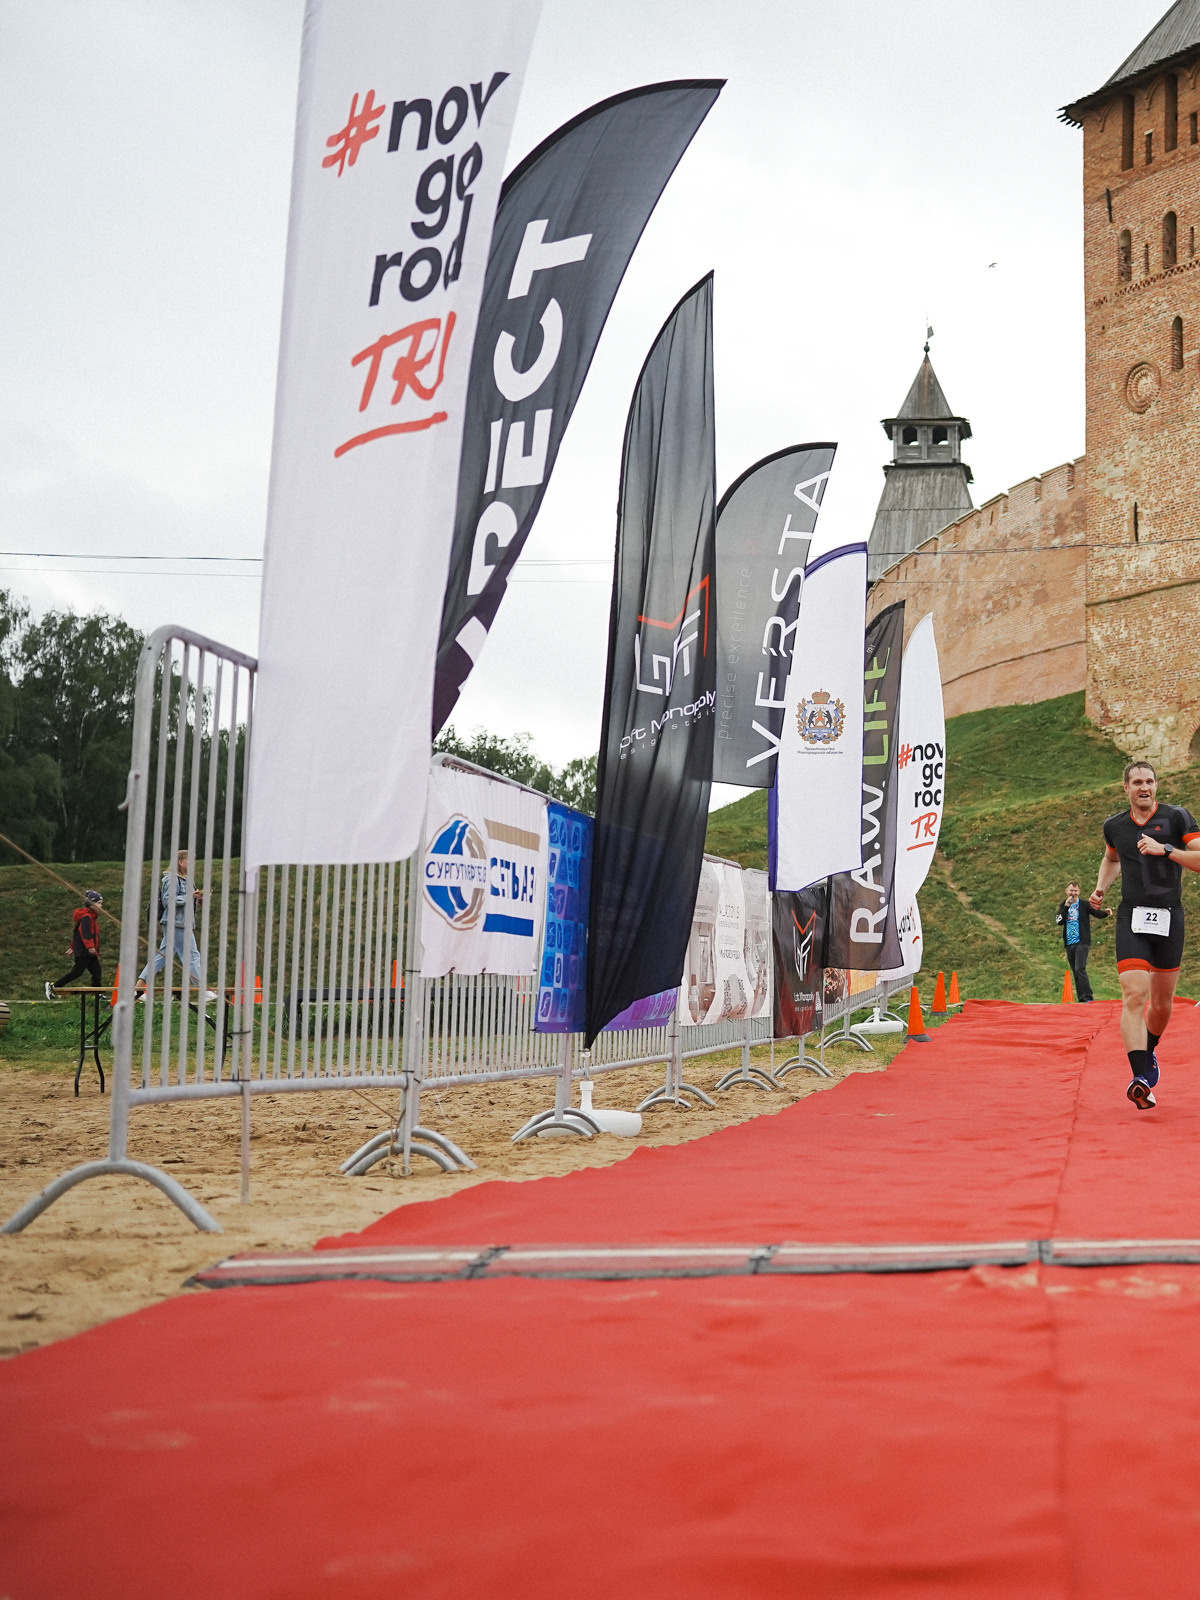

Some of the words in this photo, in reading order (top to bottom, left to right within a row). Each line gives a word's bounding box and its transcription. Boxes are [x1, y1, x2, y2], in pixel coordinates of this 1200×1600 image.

[322, 72, 511, 178] #nov
[411, 142, 483, 240] go
[369, 193, 474, 307] rod
[351, 311, 457, 413] TRI
[728, 567, 753, 665] excellence
[746, 470, 831, 768] VERSTA
[719, 672, 738, 741] precise
[862, 647, 891, 766] LIFE
[898, 742, 944, 769] #nov
[1145, 912, 1158, 922] 22
